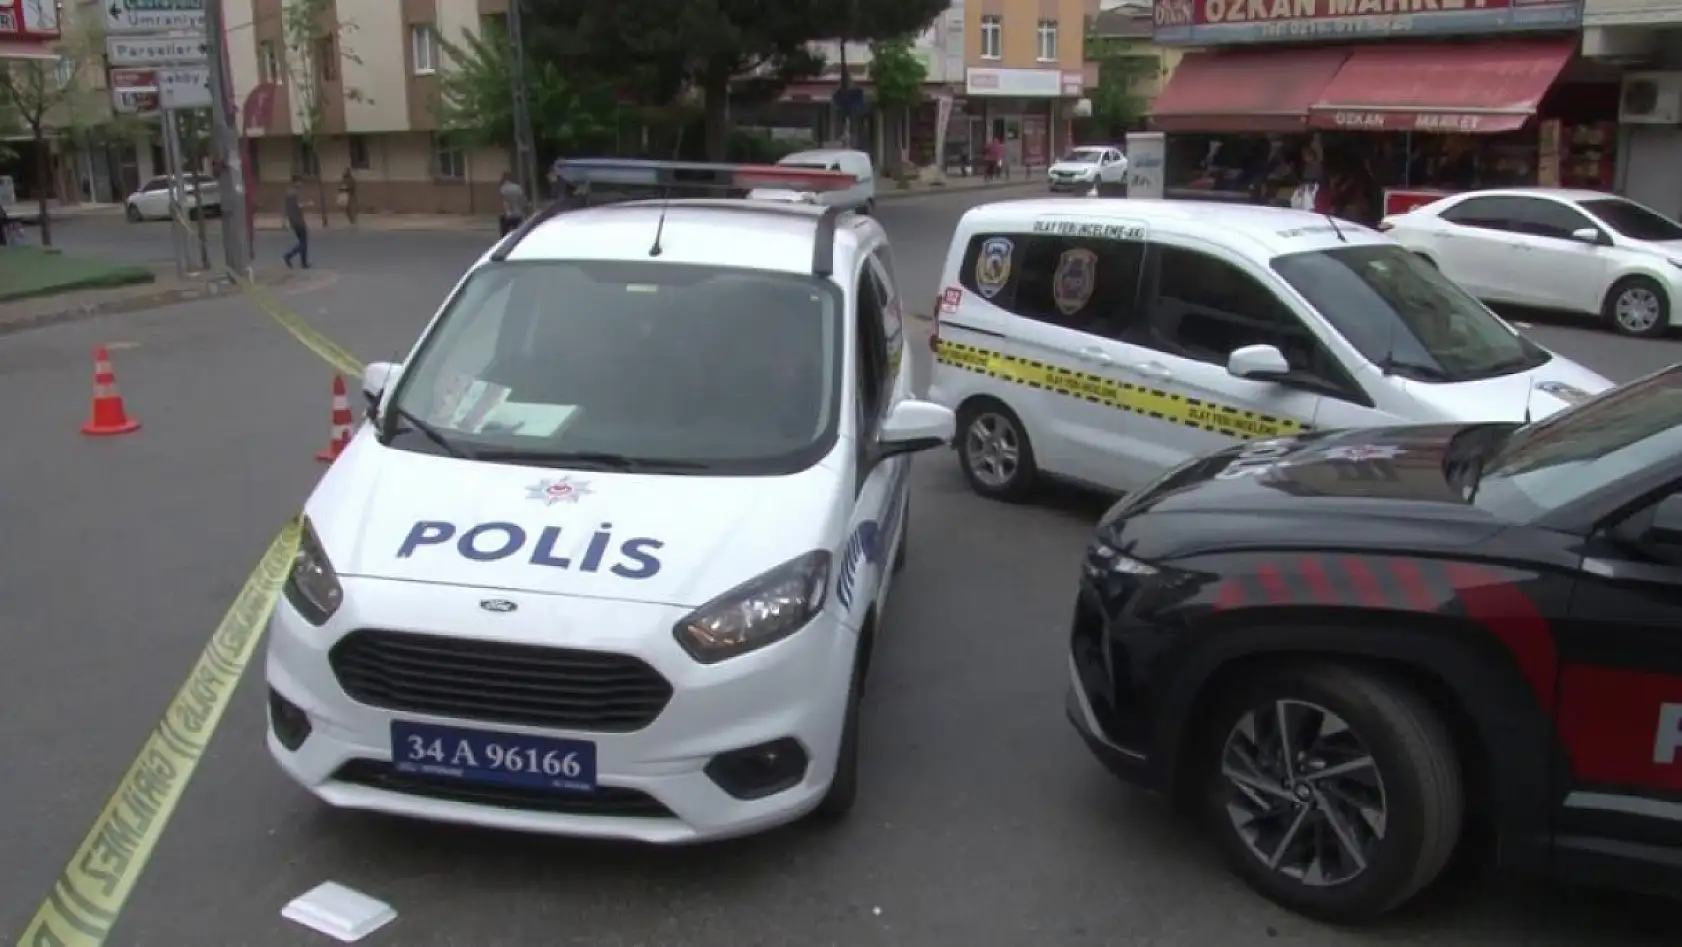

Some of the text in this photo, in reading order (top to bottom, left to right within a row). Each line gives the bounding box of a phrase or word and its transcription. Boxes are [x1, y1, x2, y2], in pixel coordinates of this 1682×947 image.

[1414, 113, 1481, 130] MARKET
[396, 520, 666, 580] POLİS
[407, 734, 445, 763] 34
[451, 739, 479, 767] A
[485, 743, 581, 778] 96166
